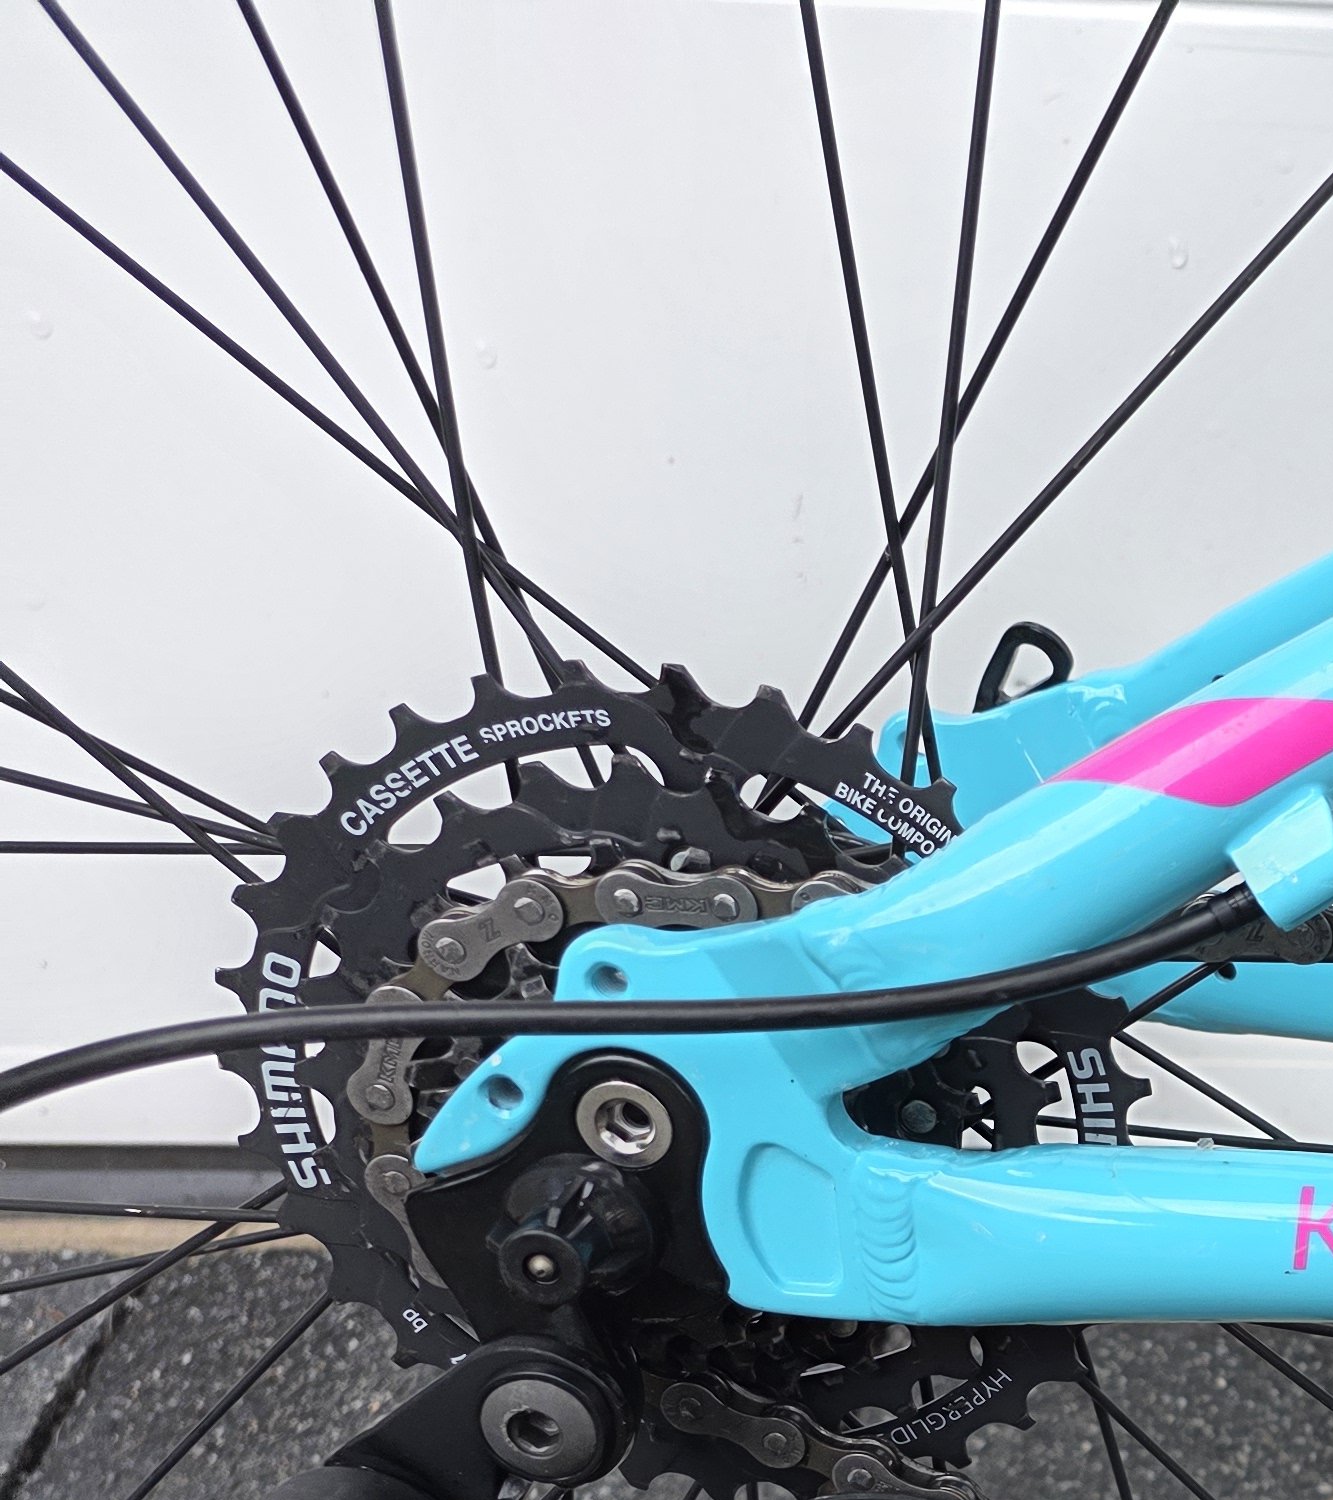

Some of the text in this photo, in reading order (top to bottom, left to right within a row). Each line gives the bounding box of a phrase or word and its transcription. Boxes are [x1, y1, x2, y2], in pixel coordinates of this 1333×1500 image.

[340, 709, 612, 836] CASSETTE SPROCKETS
[863, 771, 900, 805] THE
[834, 781, 878, 815] BIKE
